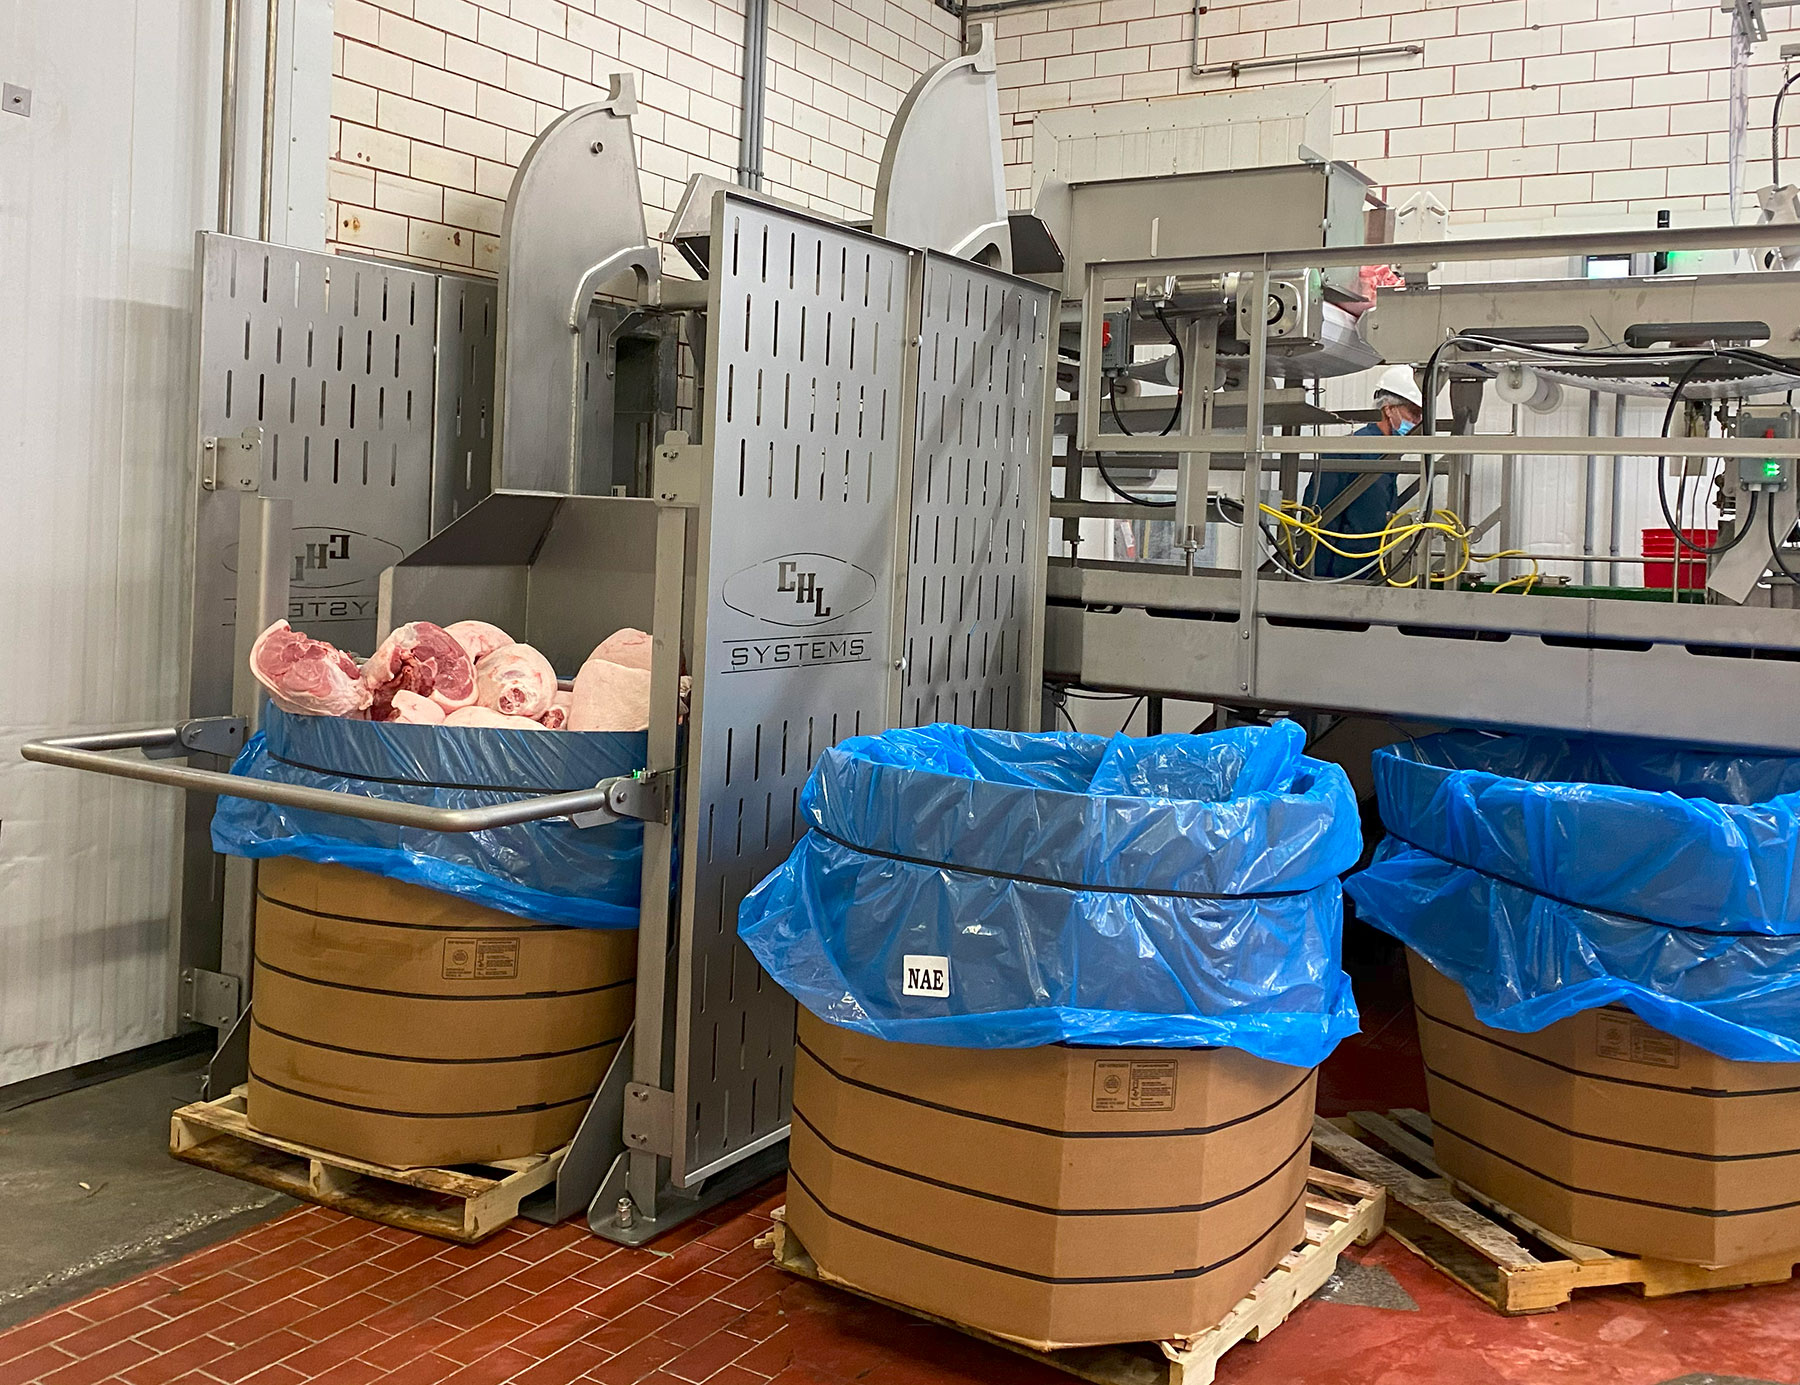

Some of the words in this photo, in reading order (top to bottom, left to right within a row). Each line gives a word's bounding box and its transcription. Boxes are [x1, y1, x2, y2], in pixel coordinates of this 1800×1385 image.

[777, 561, 831, 617] CHL
[731, 639, 864, 666] SYSTEMS
[907, 967, 944, 991] NAE
